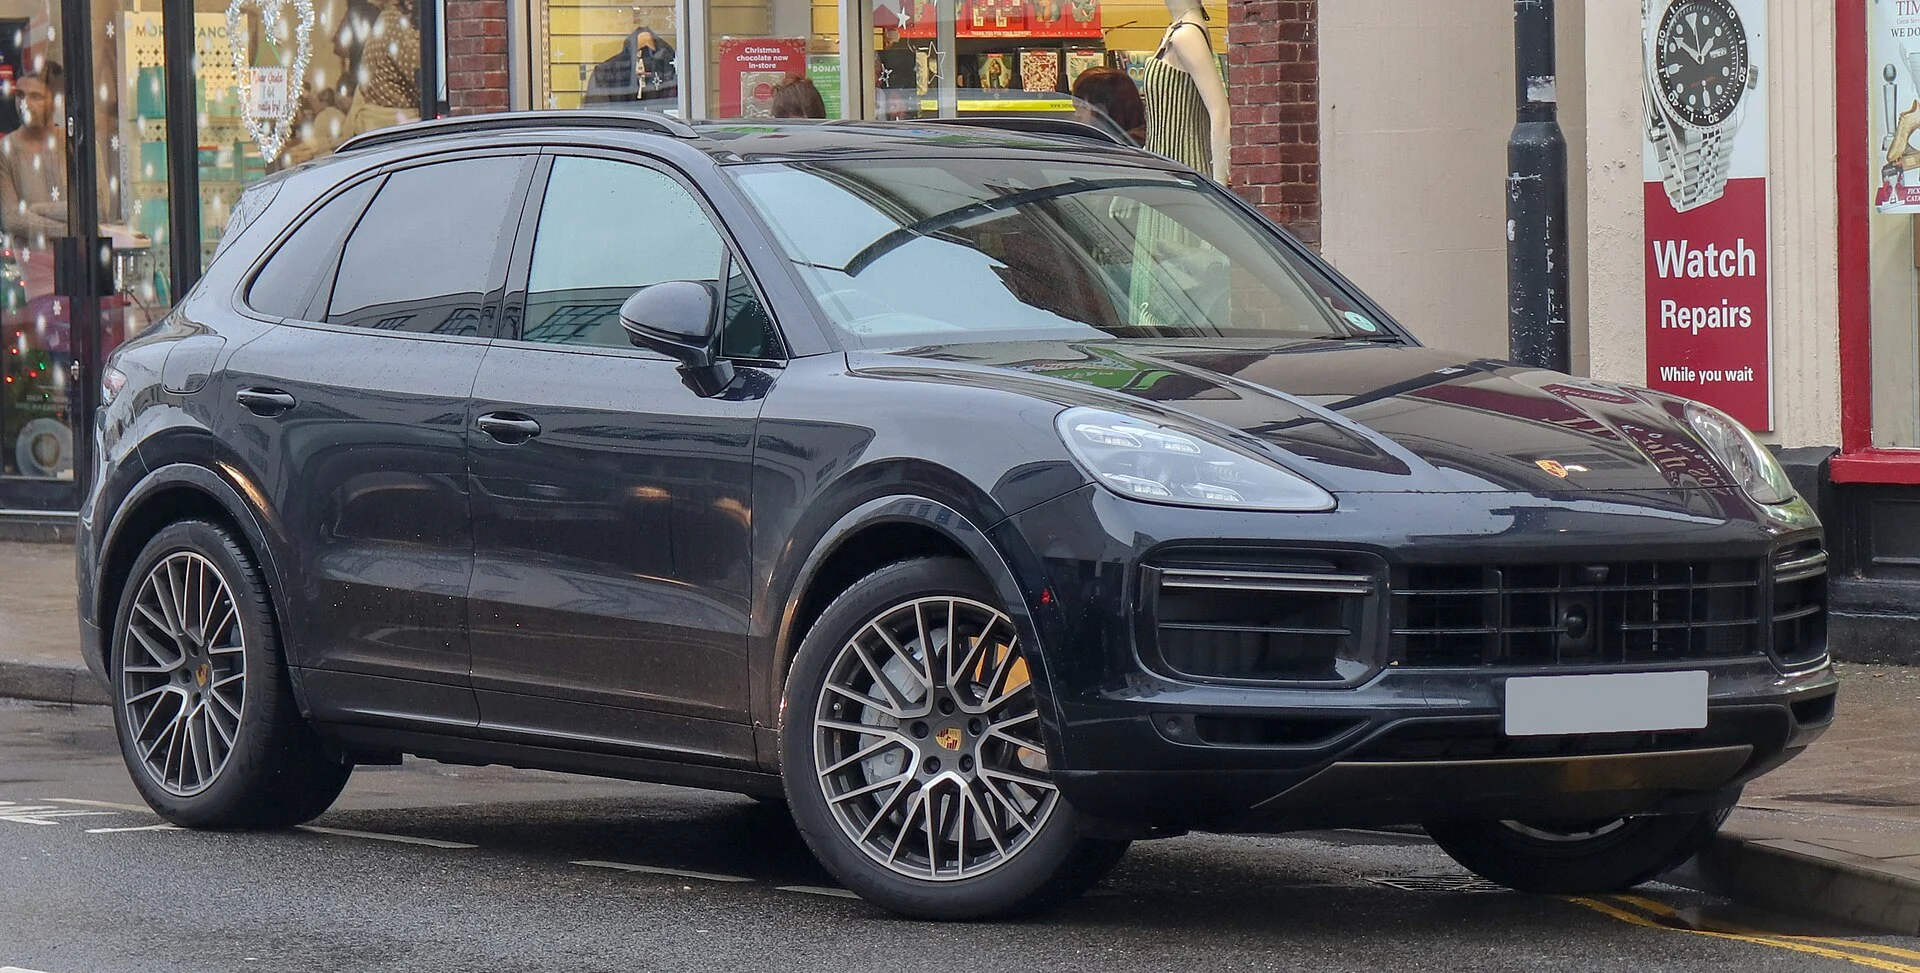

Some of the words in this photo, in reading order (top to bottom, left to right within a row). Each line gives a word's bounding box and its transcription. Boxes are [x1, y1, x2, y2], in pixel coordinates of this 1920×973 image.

[1726, 6, 1736, 20] 10
[1891, 28, 1906, 37] WE
[812, 65, 840, 73] DONAT
[1653, 238, 1756, 278] Watch
[1660, 298, 1752, 335] Repairs
[1660, 366, 1696, 382] While
[1699, 369, 1721, 385] you
[1725, 366, 1753, 382] wait
